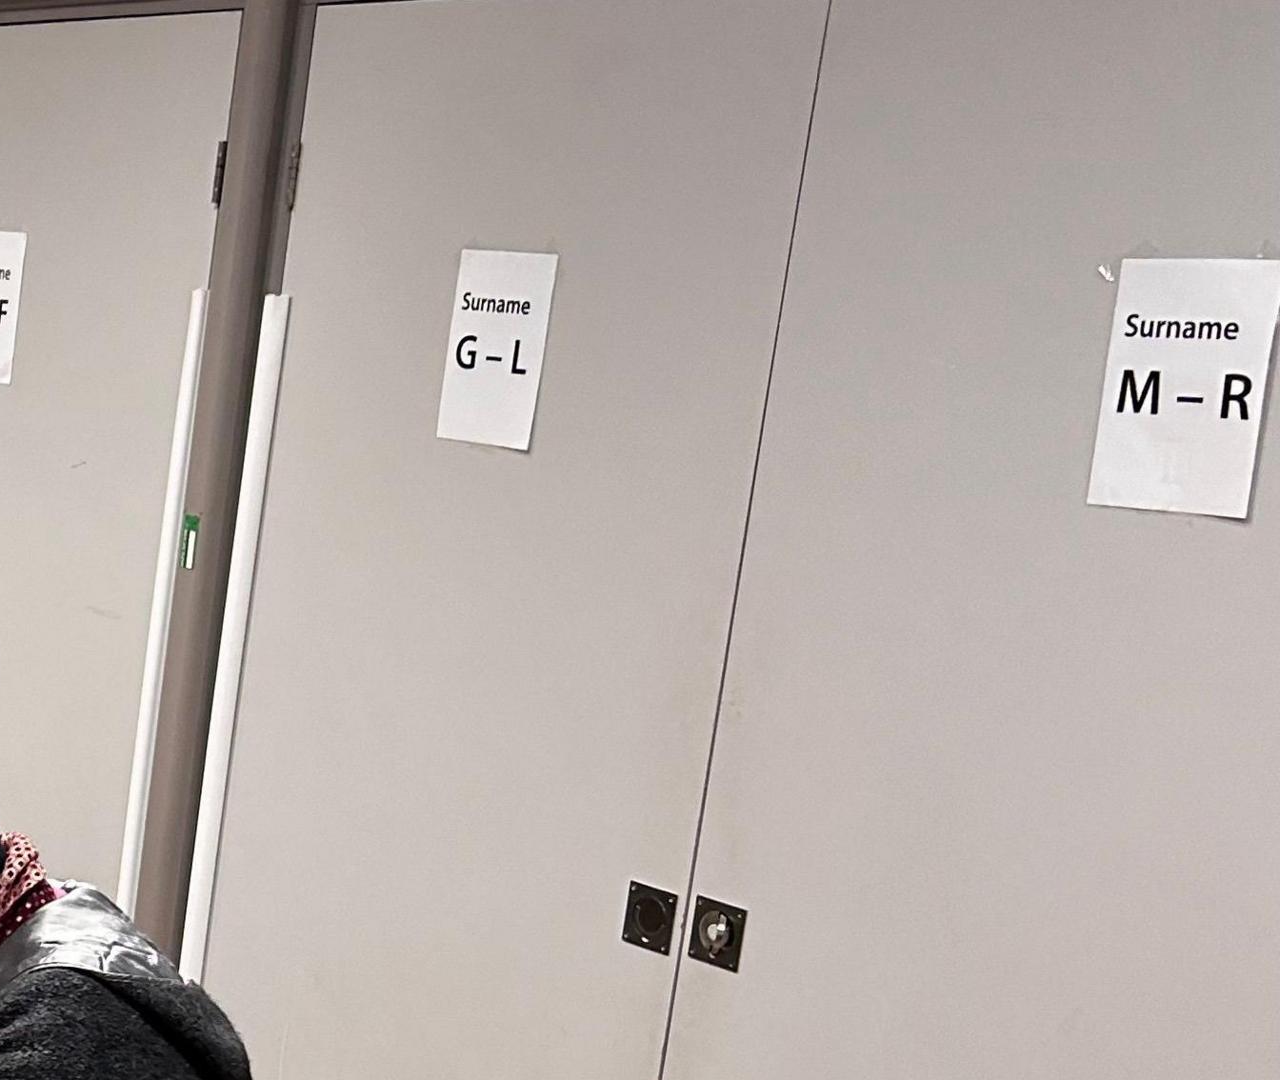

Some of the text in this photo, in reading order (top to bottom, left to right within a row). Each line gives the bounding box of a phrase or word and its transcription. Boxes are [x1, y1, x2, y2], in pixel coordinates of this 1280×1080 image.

[461, 292, 531, 315] Surname
[1124, 313, 1240, 340] Surname
[455, 334, 478, 370] G
[511, 339, 527, 375] L
[1116, 369, 1162, 416] M
[1219, 373, 1254, 420] R
